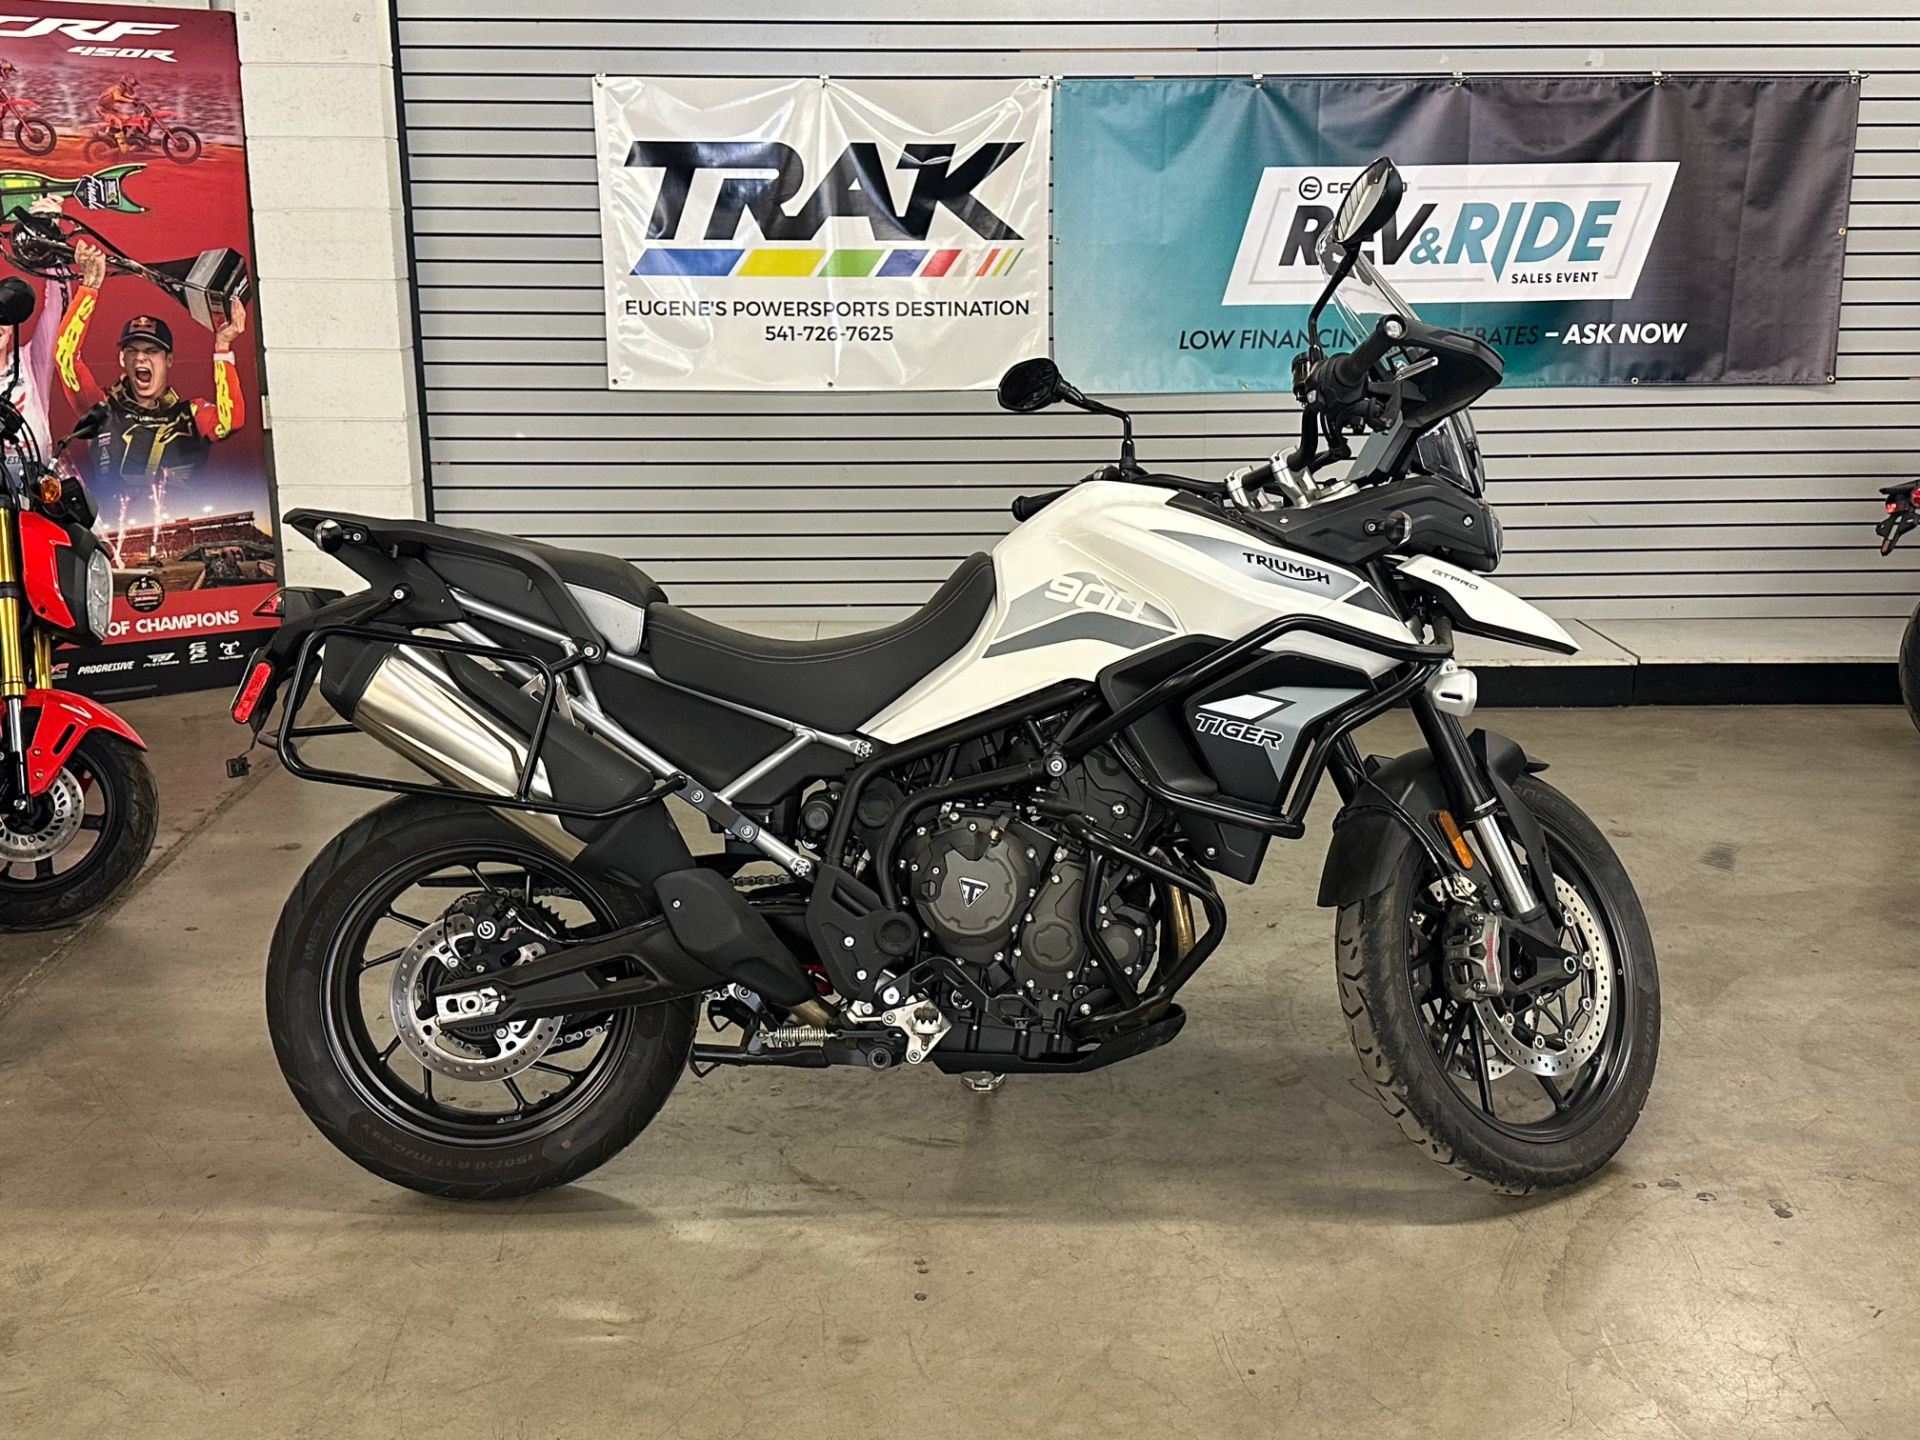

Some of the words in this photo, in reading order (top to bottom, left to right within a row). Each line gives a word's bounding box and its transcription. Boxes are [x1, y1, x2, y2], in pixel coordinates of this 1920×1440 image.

[66, 46, 178, 63] 450R
[624, 141, 1026, 241] TRAK
[1511, 273, 1552, 284] SALES
[1556, 272, 1599, 283] EVENT
[625, 300, 727, 317] EUGENE'S
[732, 301, 890, 317] POWERSPORTS
[896, 300, 1030, 317] DESTINATION
[765, 325, 894, 342] 541-726-7625
[1179, 329, 1236, 350] LOW
[1239, 328, 1363, 349] FINANCIN
[1562, 323, 1616, 345] ASK
[1618, 322, 1688, 345] NOW
[1243, 552, 1330, 585] TRIUMPH
[1044, 574, 1145, 620] 900
[107, 621, 130, 637] OF
[135, 610, 240, 634] CHAMPIONS
[77, 660, 135, 676] PROGRESSIVE
[1195, 713, 1284, 750] TIGER
